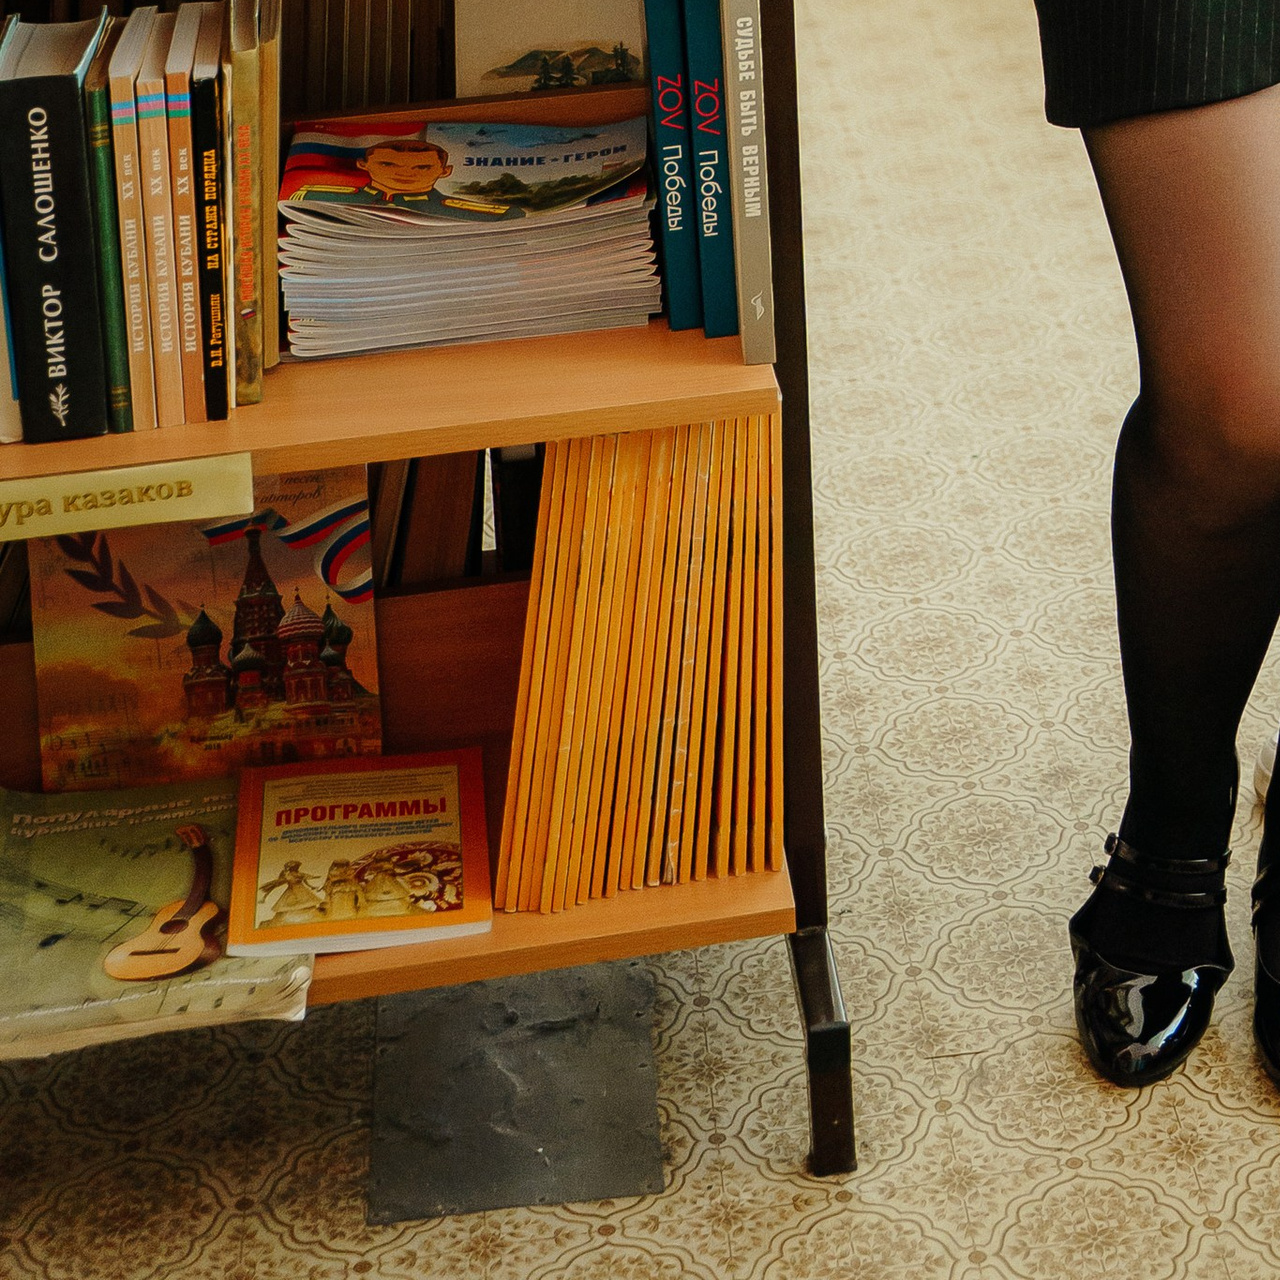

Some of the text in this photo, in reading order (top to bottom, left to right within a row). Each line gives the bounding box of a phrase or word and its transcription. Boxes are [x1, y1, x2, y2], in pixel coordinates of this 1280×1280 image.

[658, 73, 685, 130] ZOV
[694, 77, 721, 135] ZOV
[735, 17, 761, 218] СУДЬБЕ БЫТЬ ВЕРНЫМ
[463, 144, 627, 167] ЗНАНИЕ ГЕРОИ
[663, 144, 687, 231] Победы
[698, 149, 722, 237] Победы
[28, 107, 67, 378] ВИКТОР САЛОШЕНКО
[124, 219, 145, 352] ИСТОРИЯ КУБАНИ
[153, 215, 173, 352] ИСТОРИЯ КУБАНИ
[179, 214, 197, 352] ИСТОРИЯ КУБАНИ
[203, 149, 224, 345] Ратушняк НА СТРАЖЕ ПОРЯДКА
[62, 480, 194, 513] казаков
[275, 797, 446, 827] ПРОГРАММЫ
